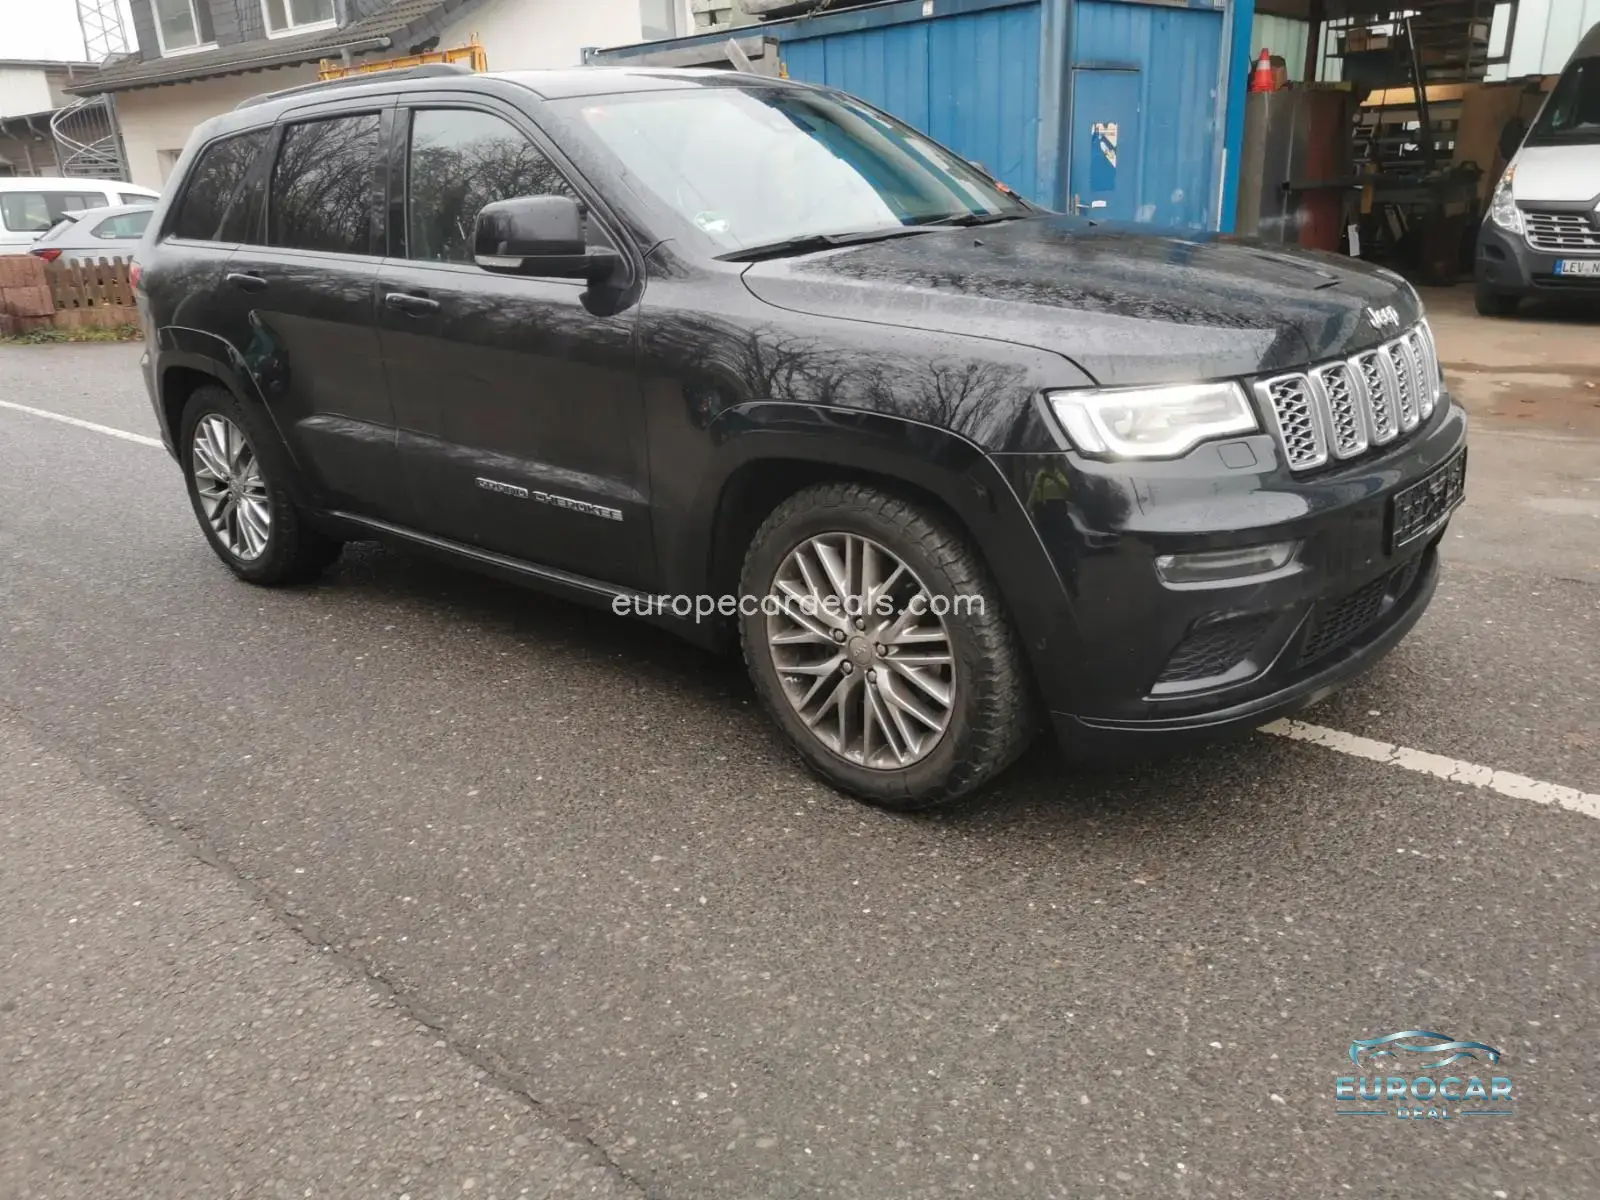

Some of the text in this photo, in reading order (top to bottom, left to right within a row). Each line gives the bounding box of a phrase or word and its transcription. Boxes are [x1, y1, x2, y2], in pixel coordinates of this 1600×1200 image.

[1562, 262, 1585, 273] LEV
[1366, 305, 1399, 329] Jeep
[532, 490, 624, 521] CHEROKEE
